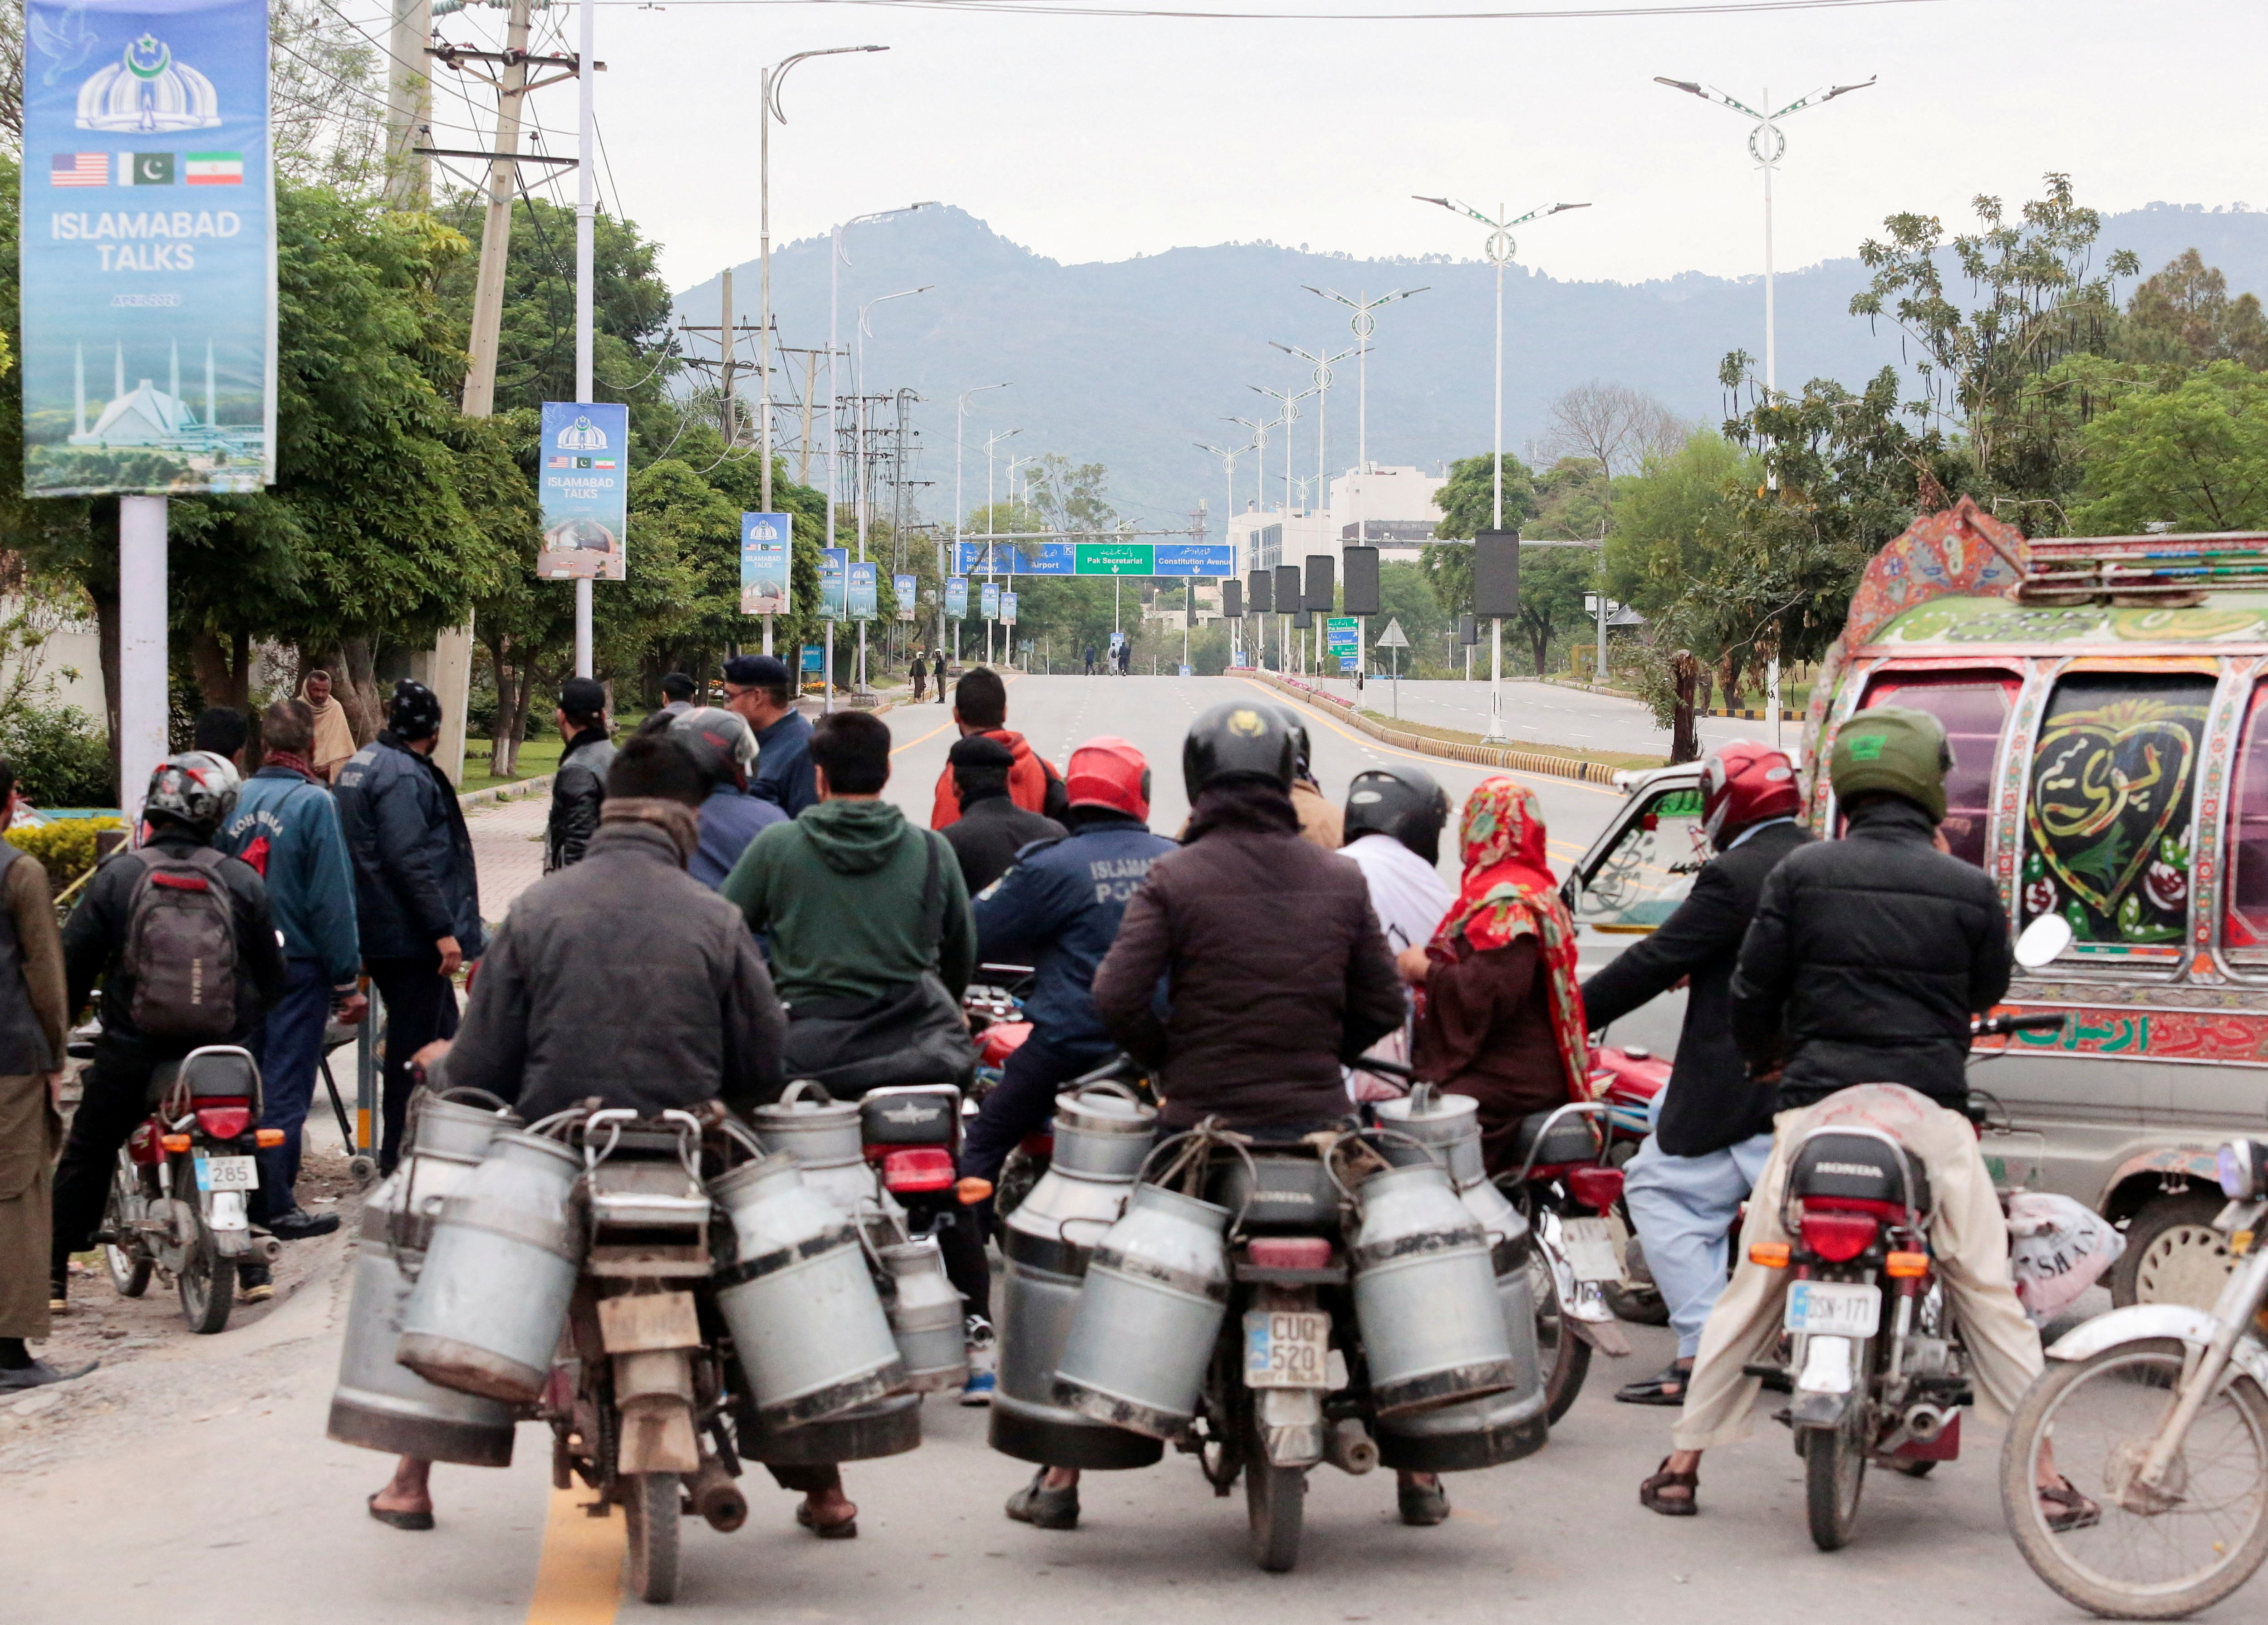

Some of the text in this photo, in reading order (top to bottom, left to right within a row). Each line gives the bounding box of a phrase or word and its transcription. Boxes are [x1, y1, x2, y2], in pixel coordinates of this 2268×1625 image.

[51, 211, 241, 240] ISLAMABAD
[95, 243, 195, 271] TALKS
[548, 477, 614, 488] ISLAMABAD
[563, 488, 599, 499] TALKS
[1090, 859, 1153, 880] ISLAMA
[213, 1166, 248, 1182] 285
[1815, 1162, 1885, 1178] HONDA
[1254, 1190, 1316, 1204] HONDA
[1272, 1345, 1316, 1371] 520
